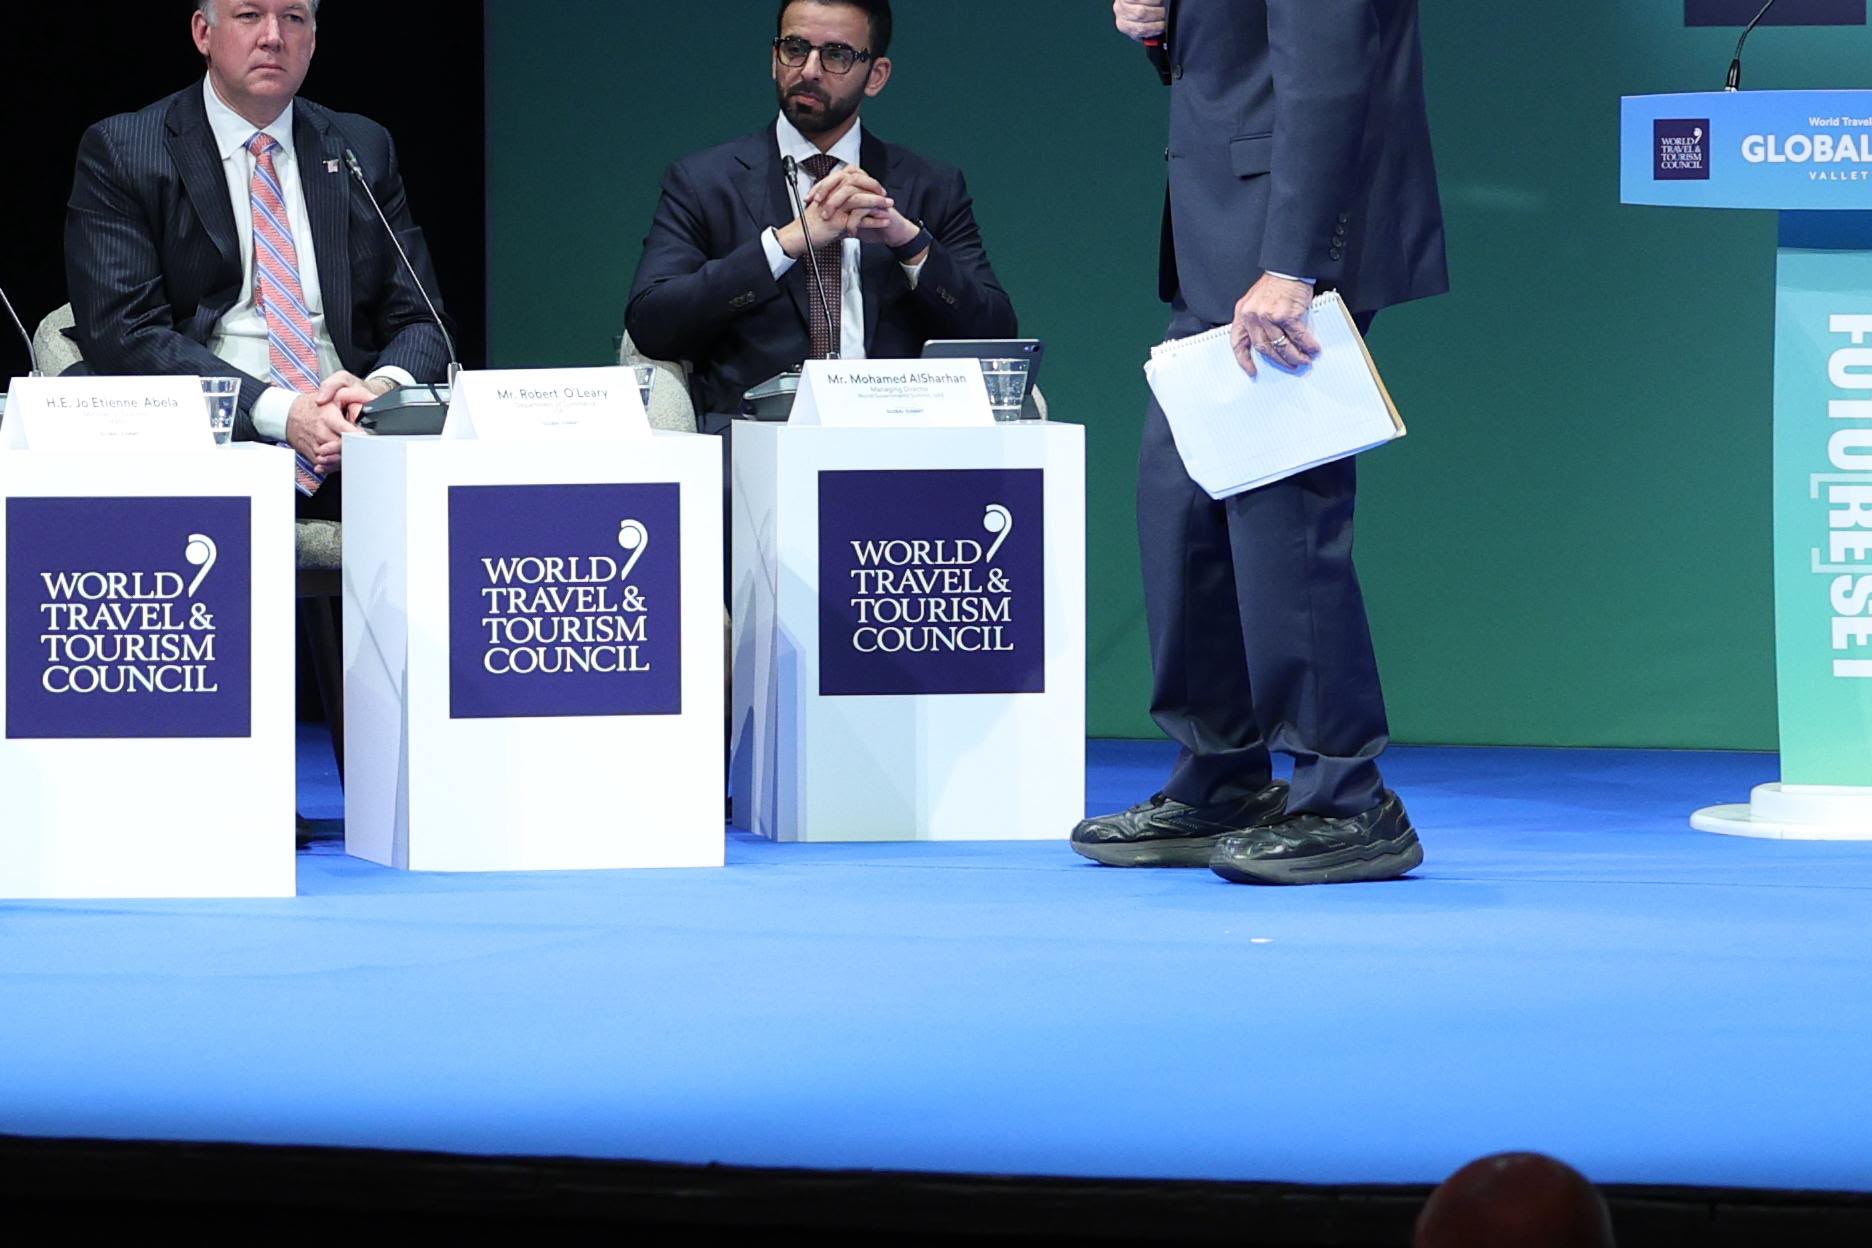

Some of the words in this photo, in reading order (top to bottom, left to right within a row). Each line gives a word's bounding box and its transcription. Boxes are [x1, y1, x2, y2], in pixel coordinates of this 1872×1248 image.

[1809, 117, 1839, 126] World
[1843, 117, 1872, 126] Travel
[1661, 137, 1694, 145] WORLD
[1661, 145, 1694, 153] TRAVEL
[1741, 134, 1872, 163] GLOBAL
[1661, 153, 1702, 161] TOURISM
[1661, 161, 1702, 169] COUNCIL
[828, 375, 847, 384] Mr.
[850, 374, 906, 384] Mohamed
[520, 389, 557, 399] Robert
[851, 539, 982, 566] WORLD
[481, 556, 617, 584] WORLD
[851, 569, 982, 594] TRAVEL
[987, 568, 1012, 592] &
[40, 572, 184, 600] WORLD
[482, 587, 617, 613] TRAVEL
[622, 586, 647, 612] &
[851, 597, 1012, 623] TOURISM
[41, 603, 184, 630] TRAVEL
[189, 603, 216, 630] &
[482, 616, 647, 644] TOURISM
[853, 626, 1014, 652] COUNCIL
[41, 634, 215, 662] TOURISM
[484, 646, 650, 674] COUNCIL
[42, 665, 217, 693] COUNCIL
